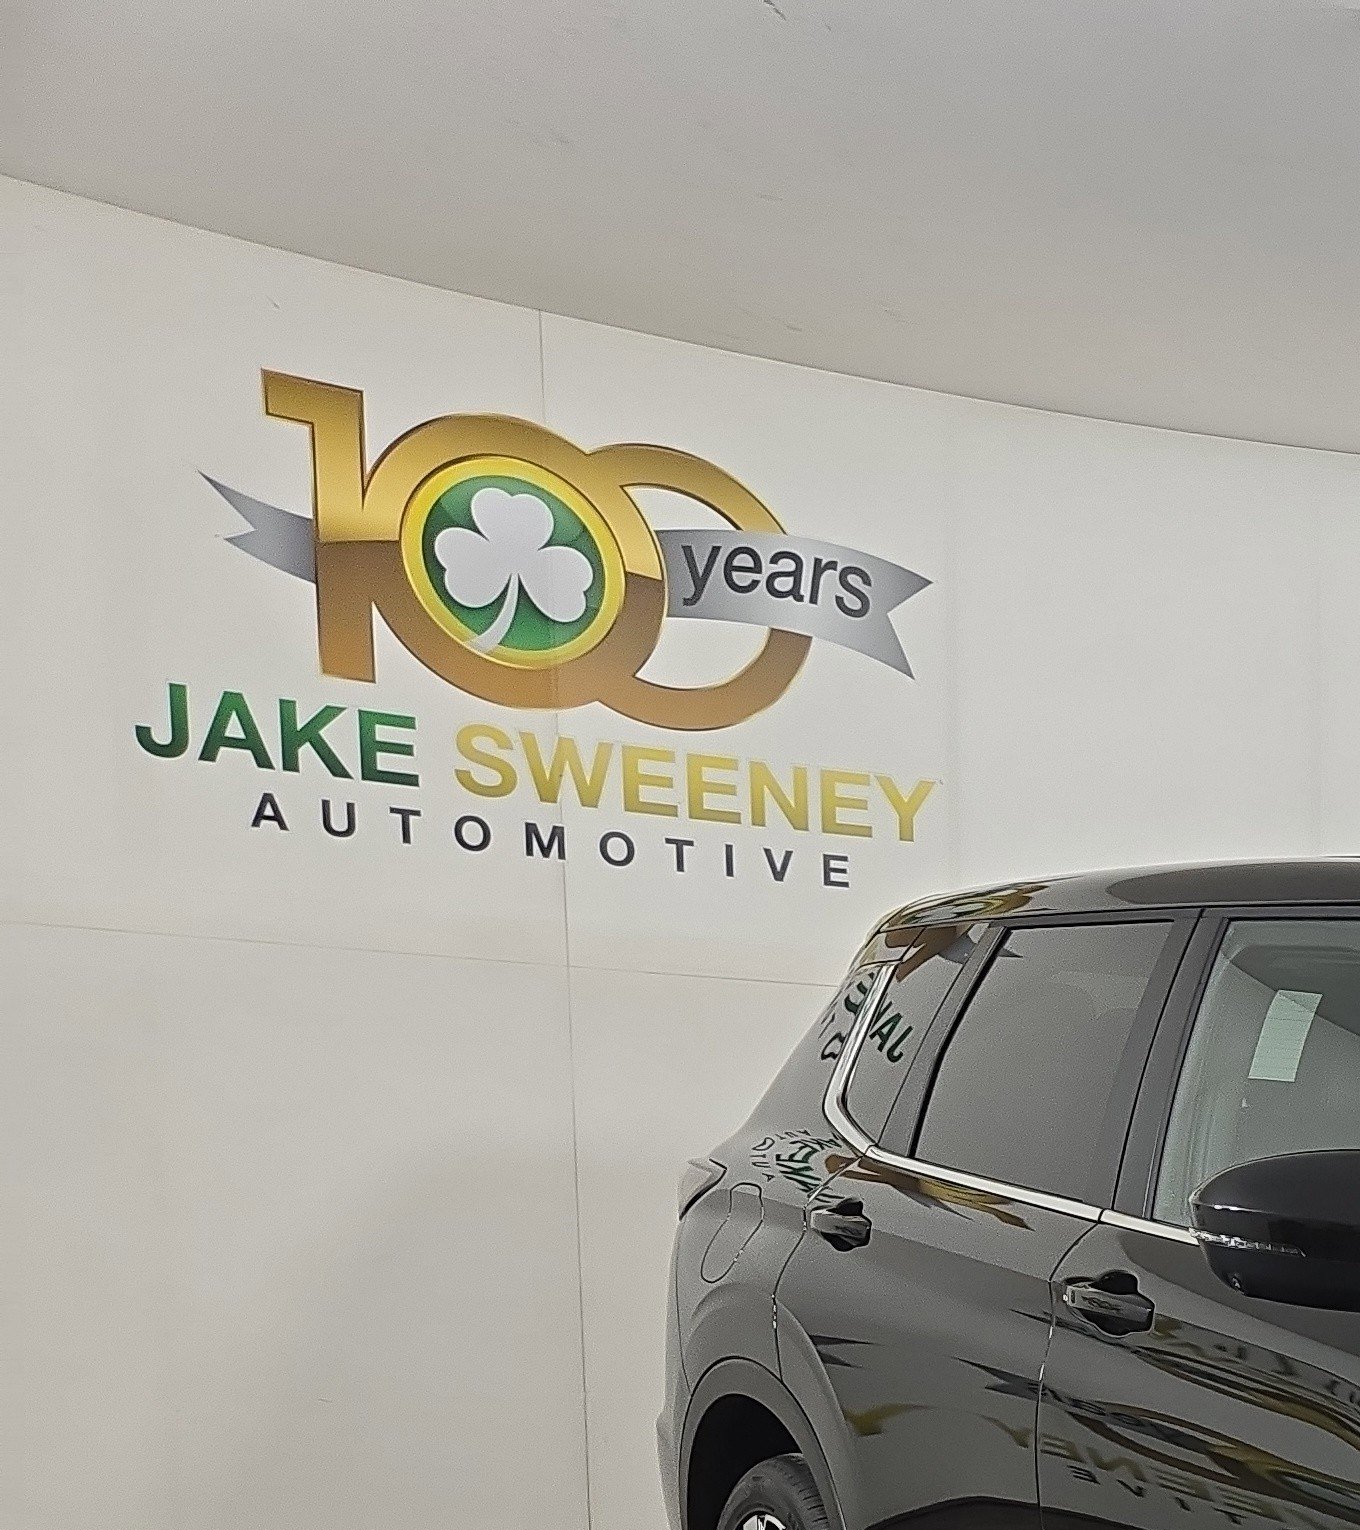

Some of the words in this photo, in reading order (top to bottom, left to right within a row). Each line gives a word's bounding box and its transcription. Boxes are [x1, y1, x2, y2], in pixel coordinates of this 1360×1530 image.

[260, 367, 812, 732] 100
[681, 541, 874, 619] years
[134, 681, 420, 789] JAKE
[454, 722, 939, 842] SWEENEY
[251, 792, 851, 889] AUTOMOTIVE
